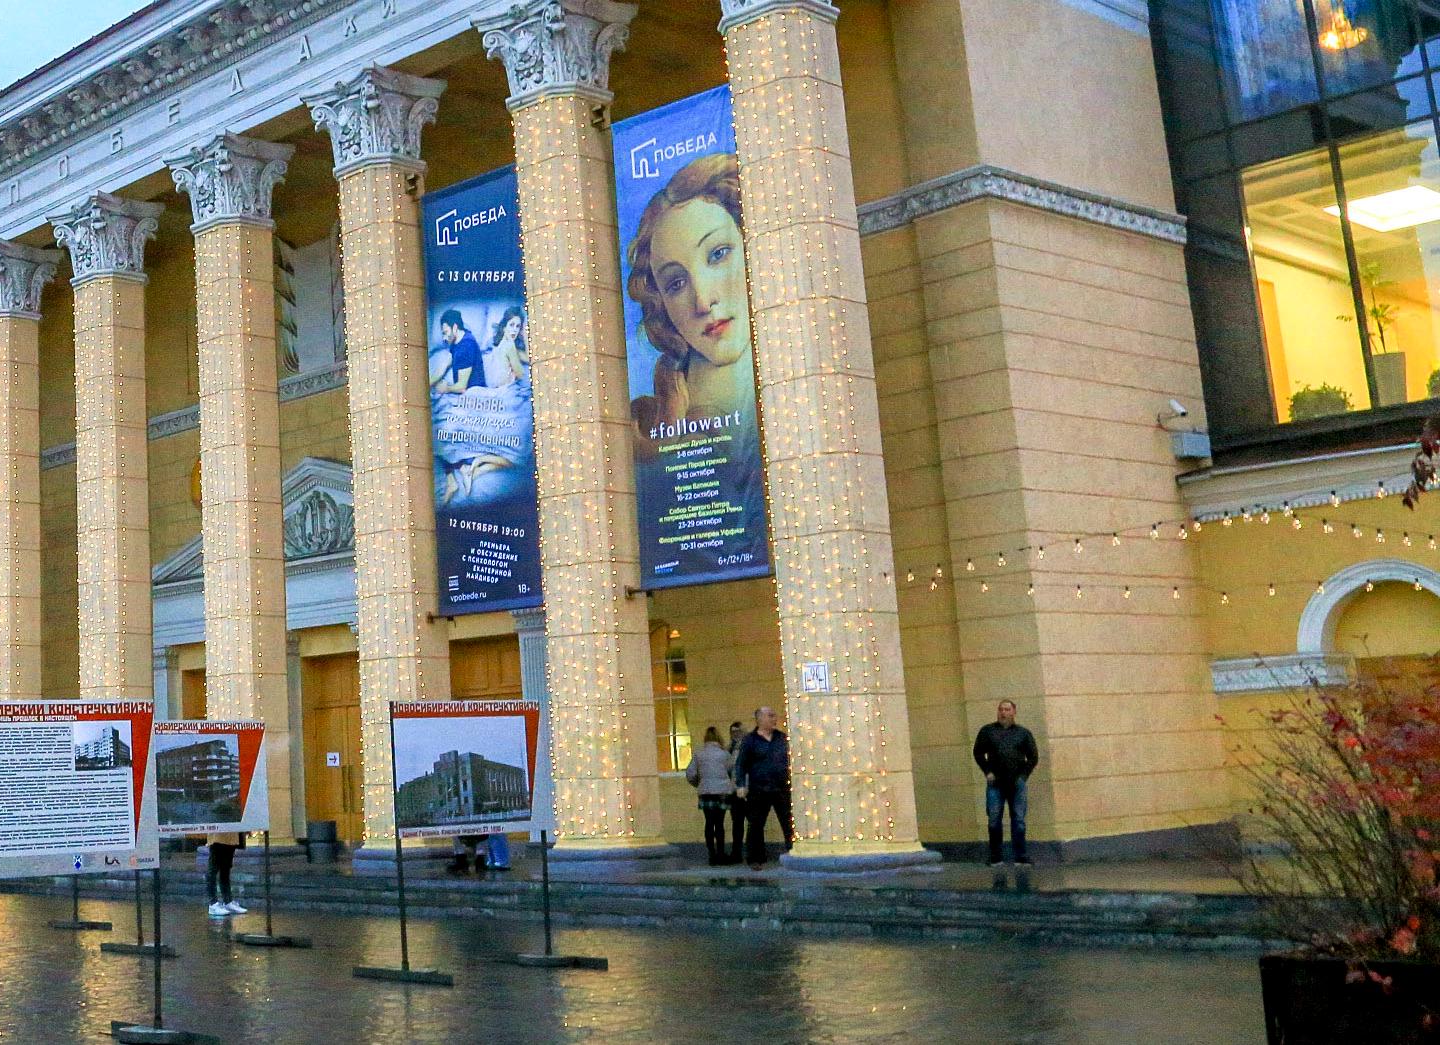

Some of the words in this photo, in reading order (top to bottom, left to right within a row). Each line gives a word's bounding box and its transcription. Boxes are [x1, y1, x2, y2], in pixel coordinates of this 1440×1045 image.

[654, 131, 717, 163] ПОБЕДА
[454, 204, 507, 232] ПОБЕДА
[438, 271, 445, 281] С
[449, 271, 459, 281] 13
[463, 271, 515, 281] ОКТЯБРЯ
[649, 410, 741, 439] #followart
[449, 518, 458, 528] 12
[460, 519, 498, 534] ОКТЯБРЯ
[501, 526, 525, 538] 19:00
[479, 540, 511, 552] ПРЕМЬЕРА
[467, 555, 509, 568] ПСИХОЛОГОМ
[476, 548, 519, 562] ОБСУЖДЕНИЕ
[472, 564, 512, 577] ЕКАТЕРИНОЙ
[465, 572, 499, 584] МАЙДИБОР
[518, 583, 531, 594] 18+
[450, 592, 487, 602] vpobede.ru
[48, 702, 154, 715] КОНСТРУКТИВИЗМ
[392, 701, 465, 713] НОВОСИБИРСКИЙ
